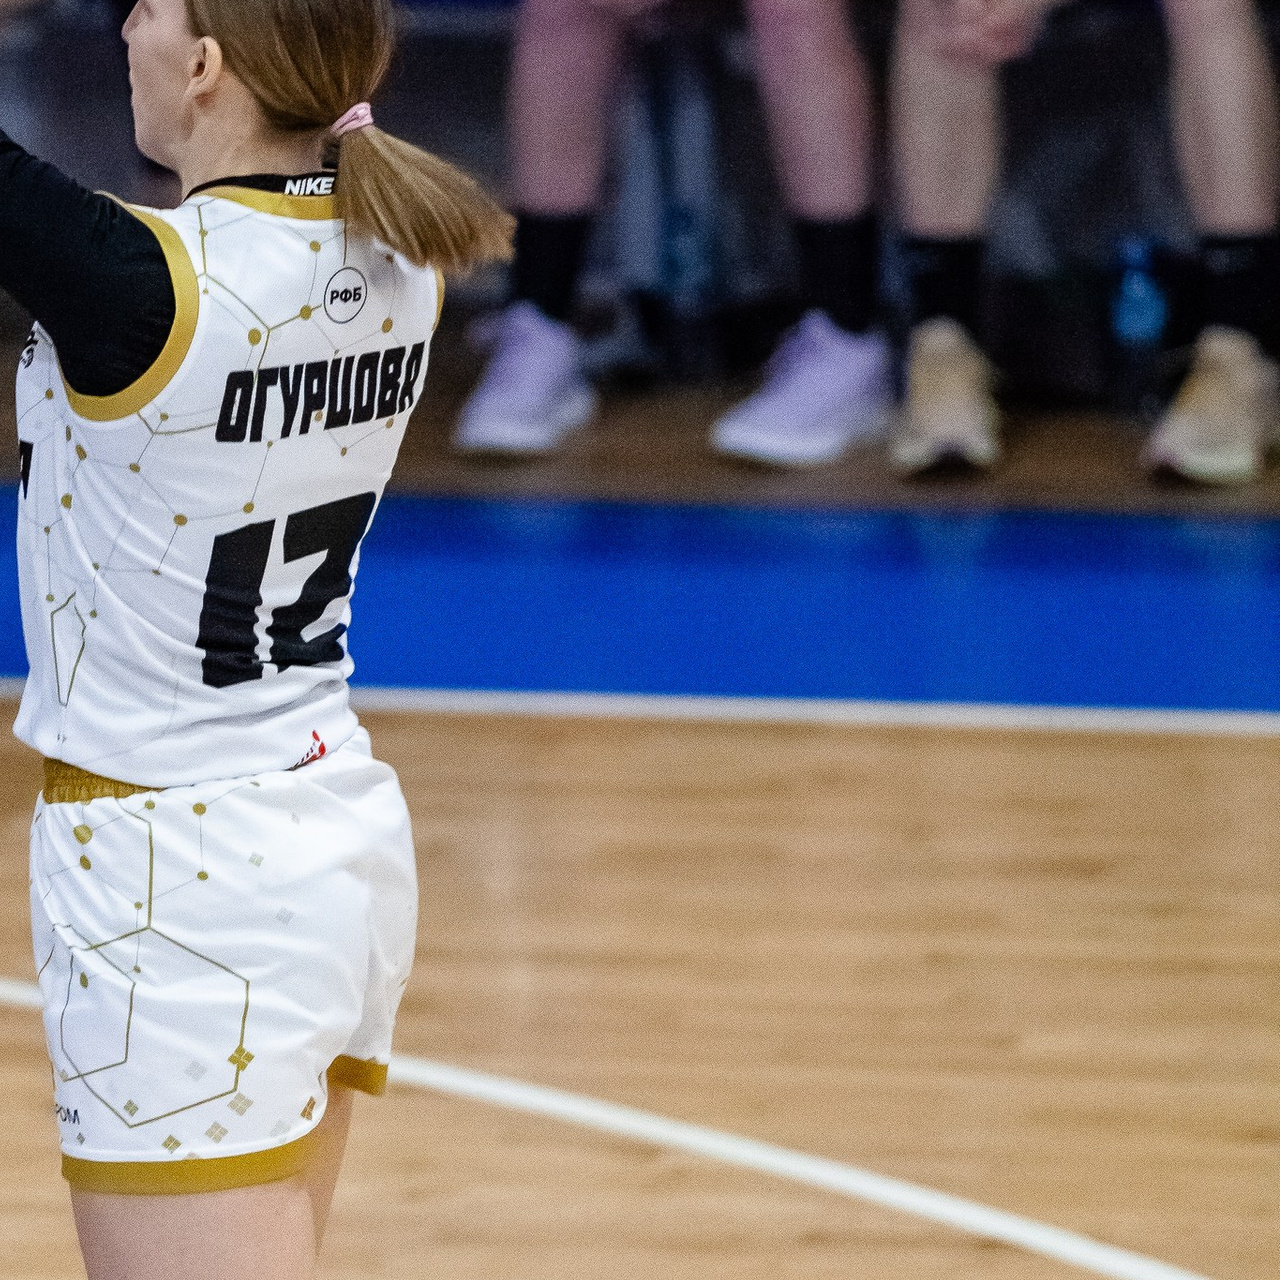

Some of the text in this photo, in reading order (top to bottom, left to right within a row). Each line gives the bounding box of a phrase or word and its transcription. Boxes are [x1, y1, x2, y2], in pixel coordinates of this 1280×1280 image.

[284, 176, 335, 195] NIKE
[329, 286, 362, 305] РФБ
[215, 340, 426, 443] ОГУРЦОВА
[195, 490, 377, 689] 12
